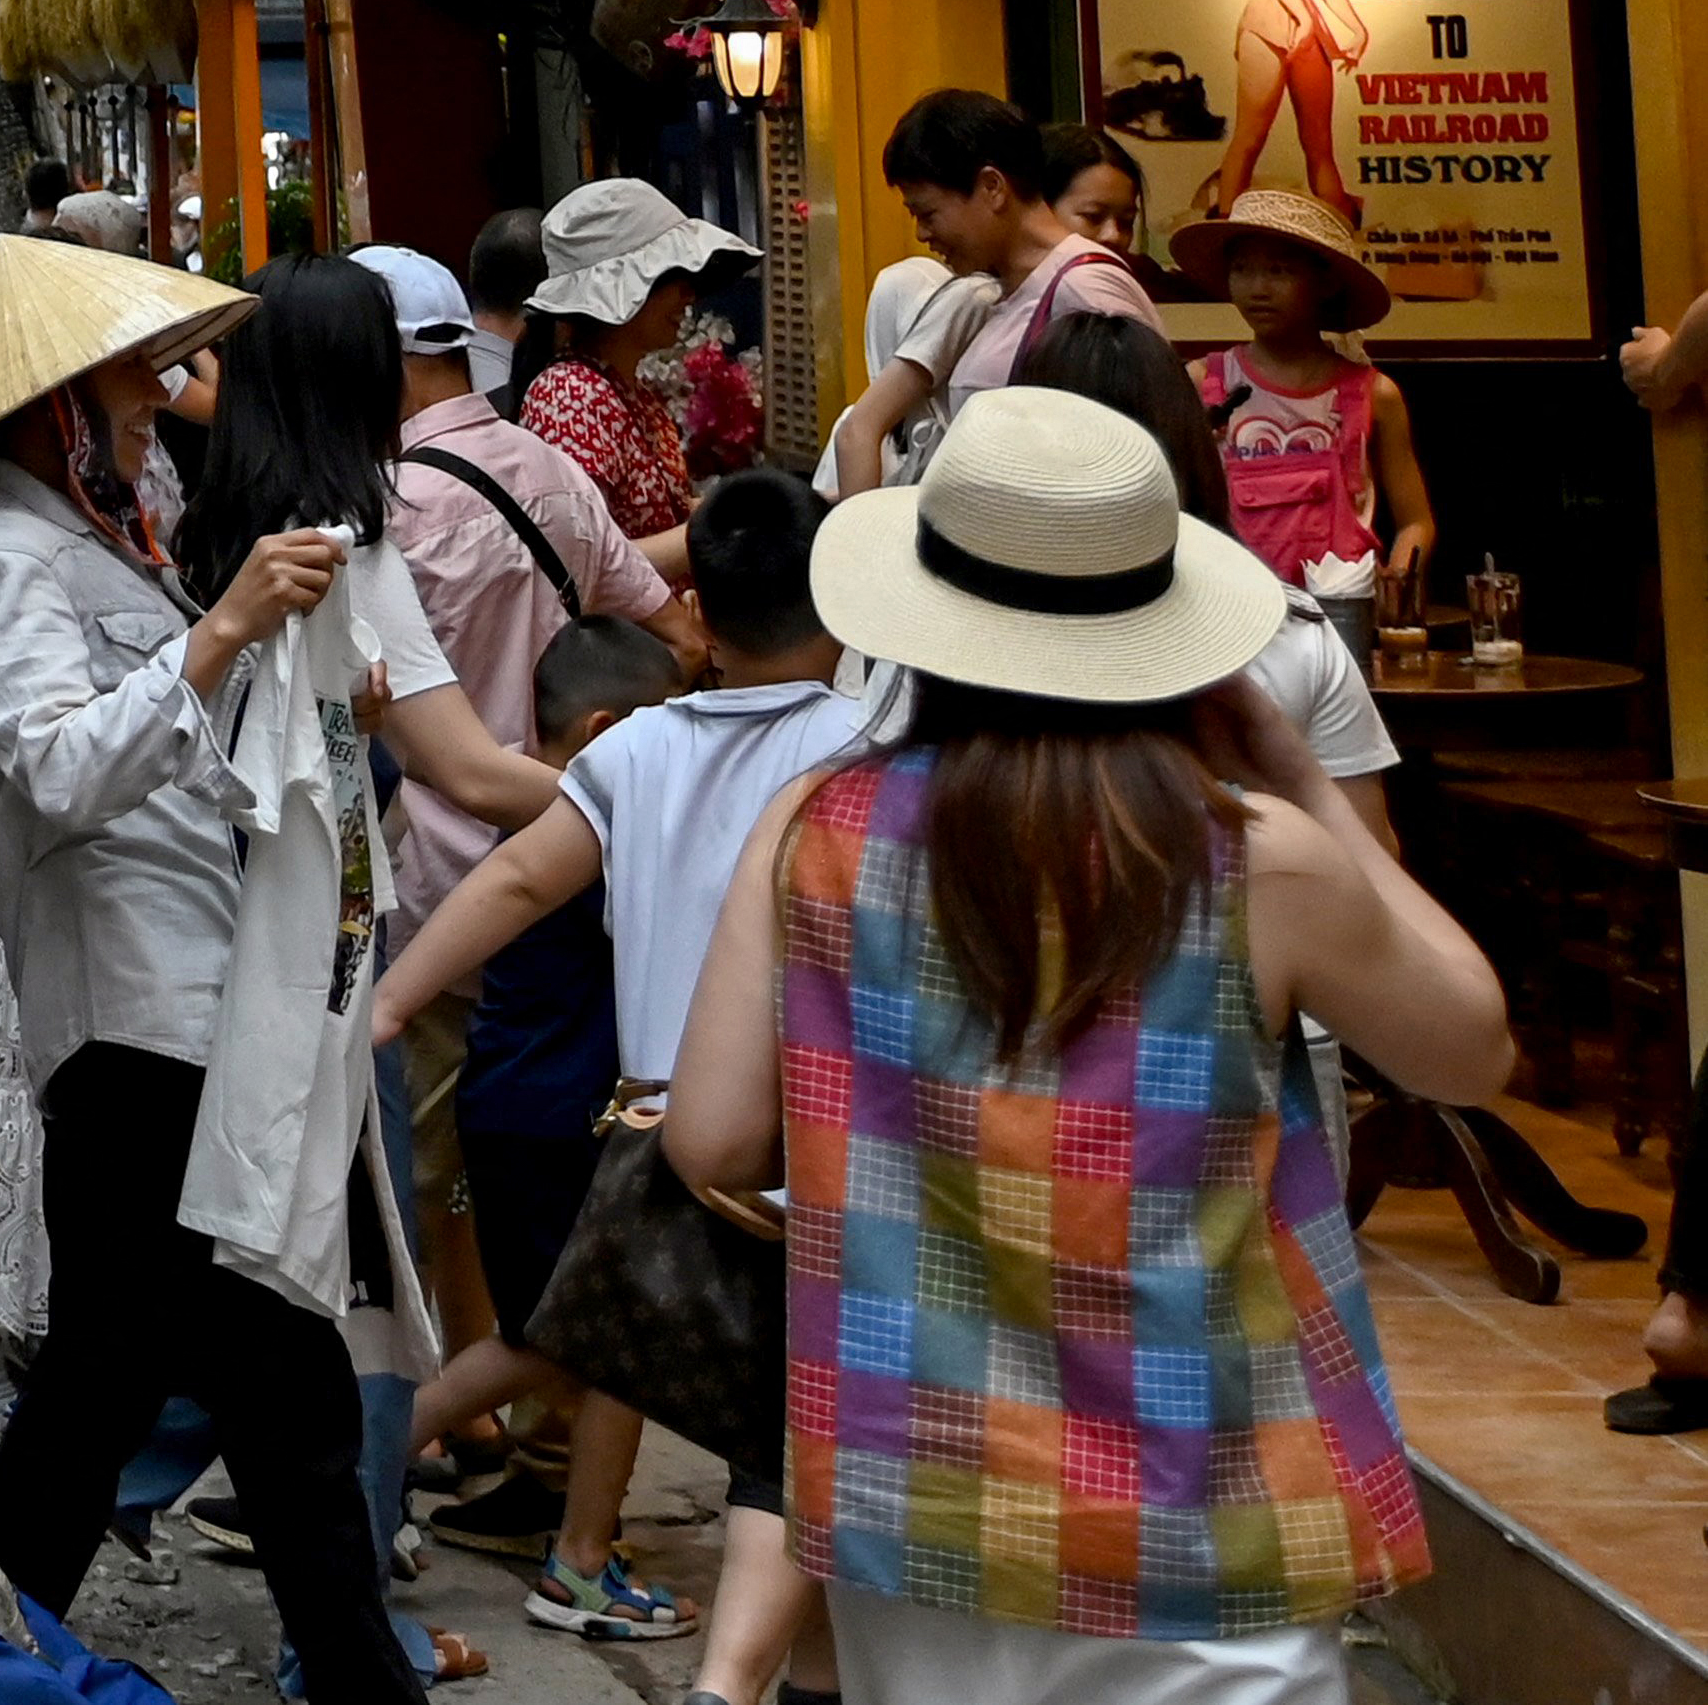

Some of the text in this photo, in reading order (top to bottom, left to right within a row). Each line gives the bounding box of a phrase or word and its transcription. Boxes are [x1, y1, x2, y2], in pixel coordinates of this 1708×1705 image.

[1427, 15, 1468, 59] TO
[1356, 71, 1549, 104] VIETNAM
[1358, 114, 1549, 144] RAILROAD
[1358, 155, 1552, 184] HISTORY
